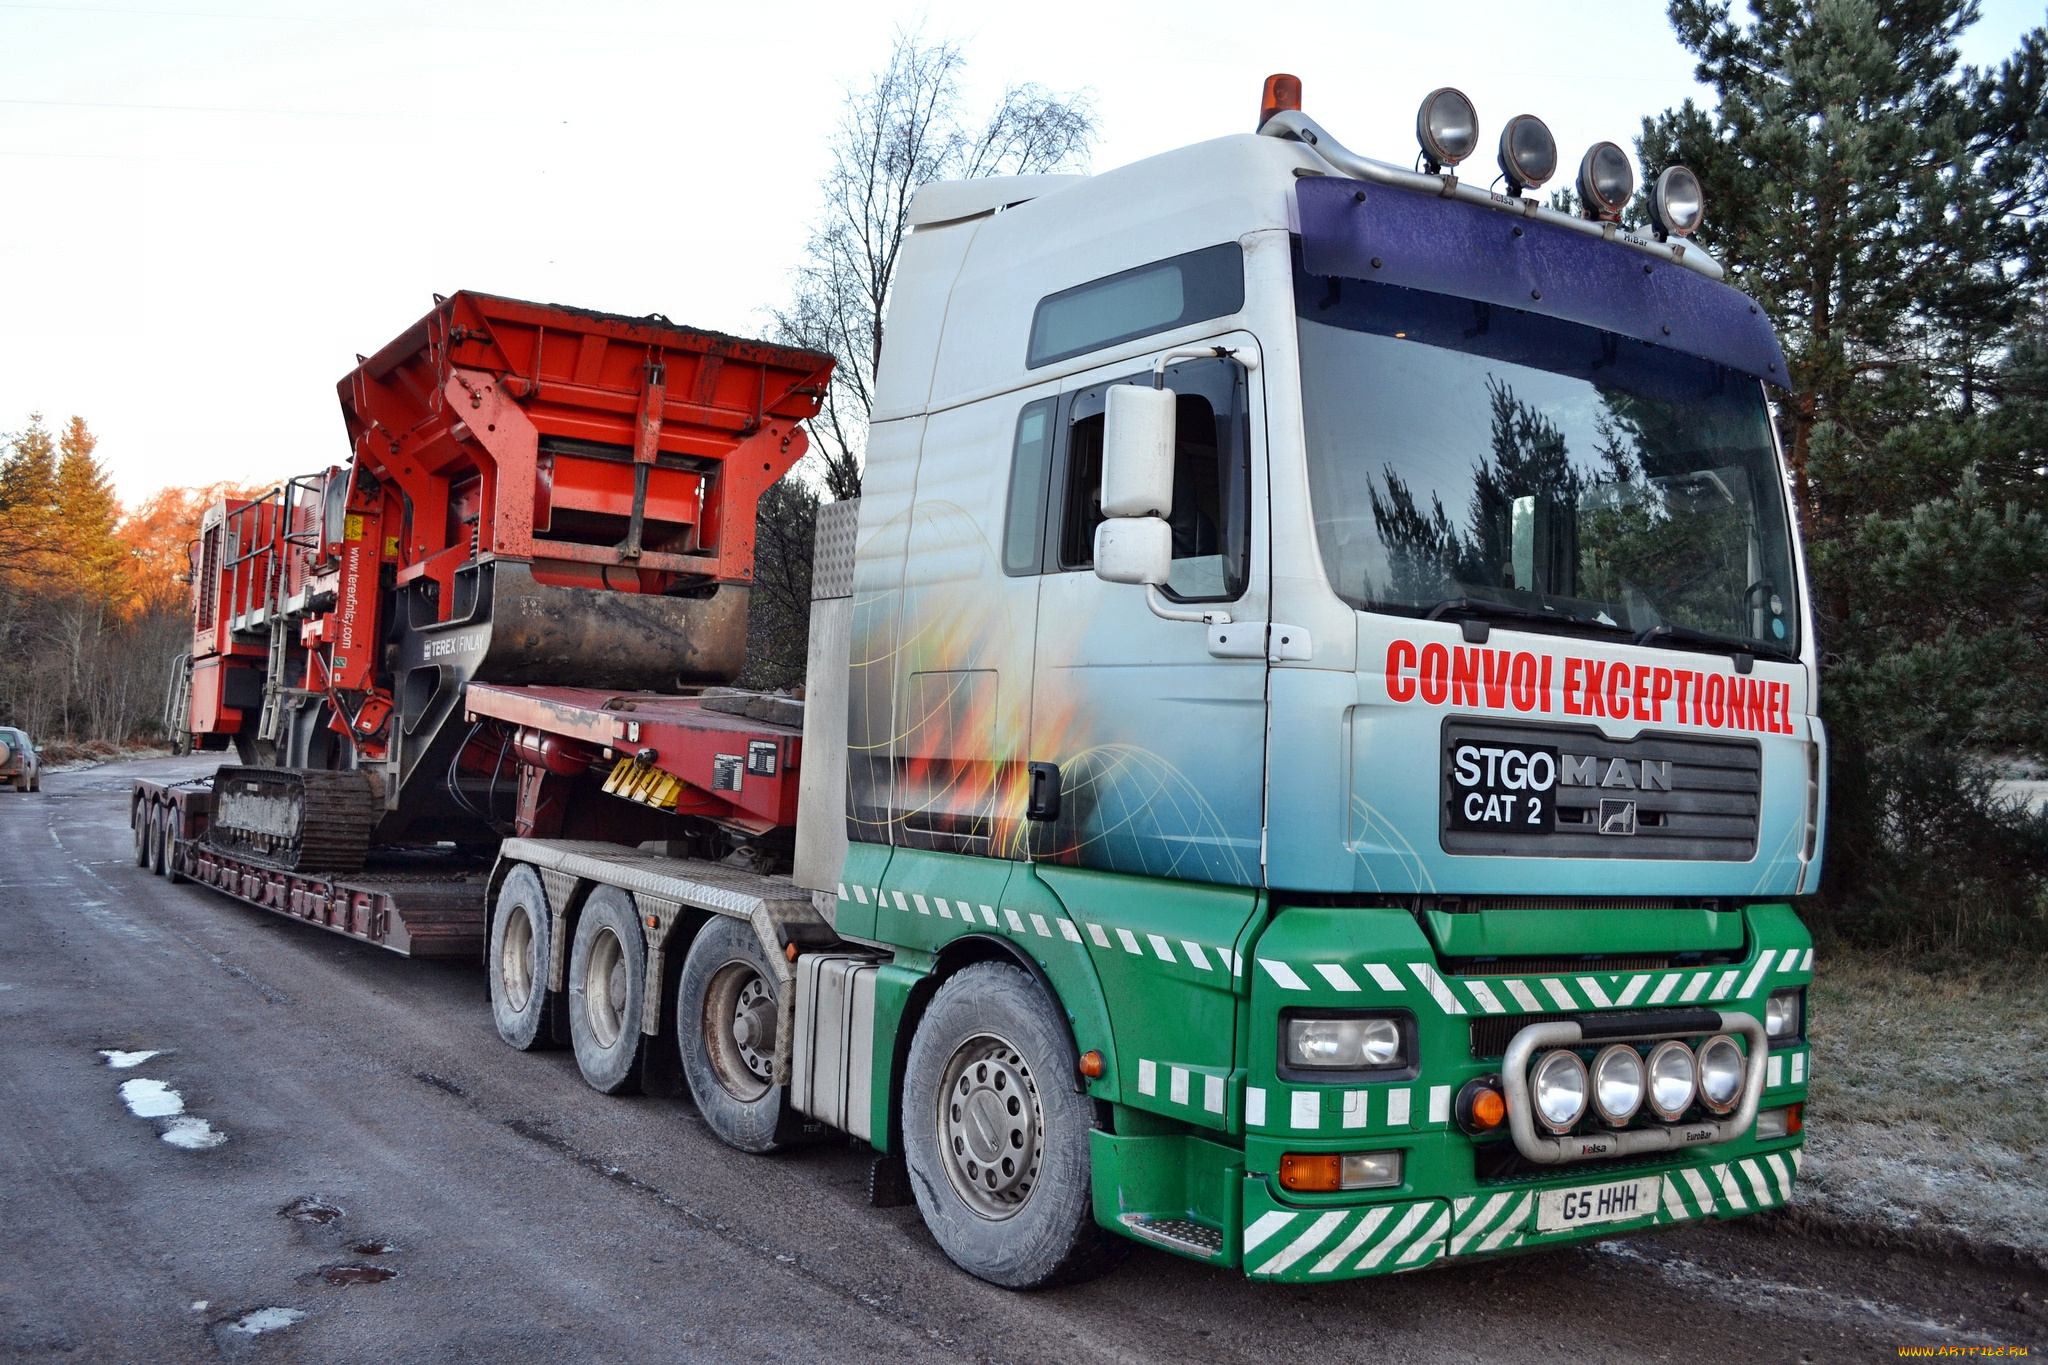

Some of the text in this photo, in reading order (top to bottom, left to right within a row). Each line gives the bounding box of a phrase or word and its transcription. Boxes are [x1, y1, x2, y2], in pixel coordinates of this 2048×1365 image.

[1623, 233, 1648, 247] HiBar
[342, 547, 360, 649] www.terexfinlay.com
[431, 633, 485, 657] TEREX FINLAY
[1384, 639, 1794, 735] CONVOI EXCEPTIONNEL
[1454, 745, 1556, 792] STGO
[1561, 754, 1673, 791] MAN
[1463, 793, 1542, 825] CAT 2
[1582, 1143, 1607, 1155] Kelsa
[1686, 1131, 1712, 1142] EuroBar
[1563, 1184, 1638, 1221] G5 HHH
